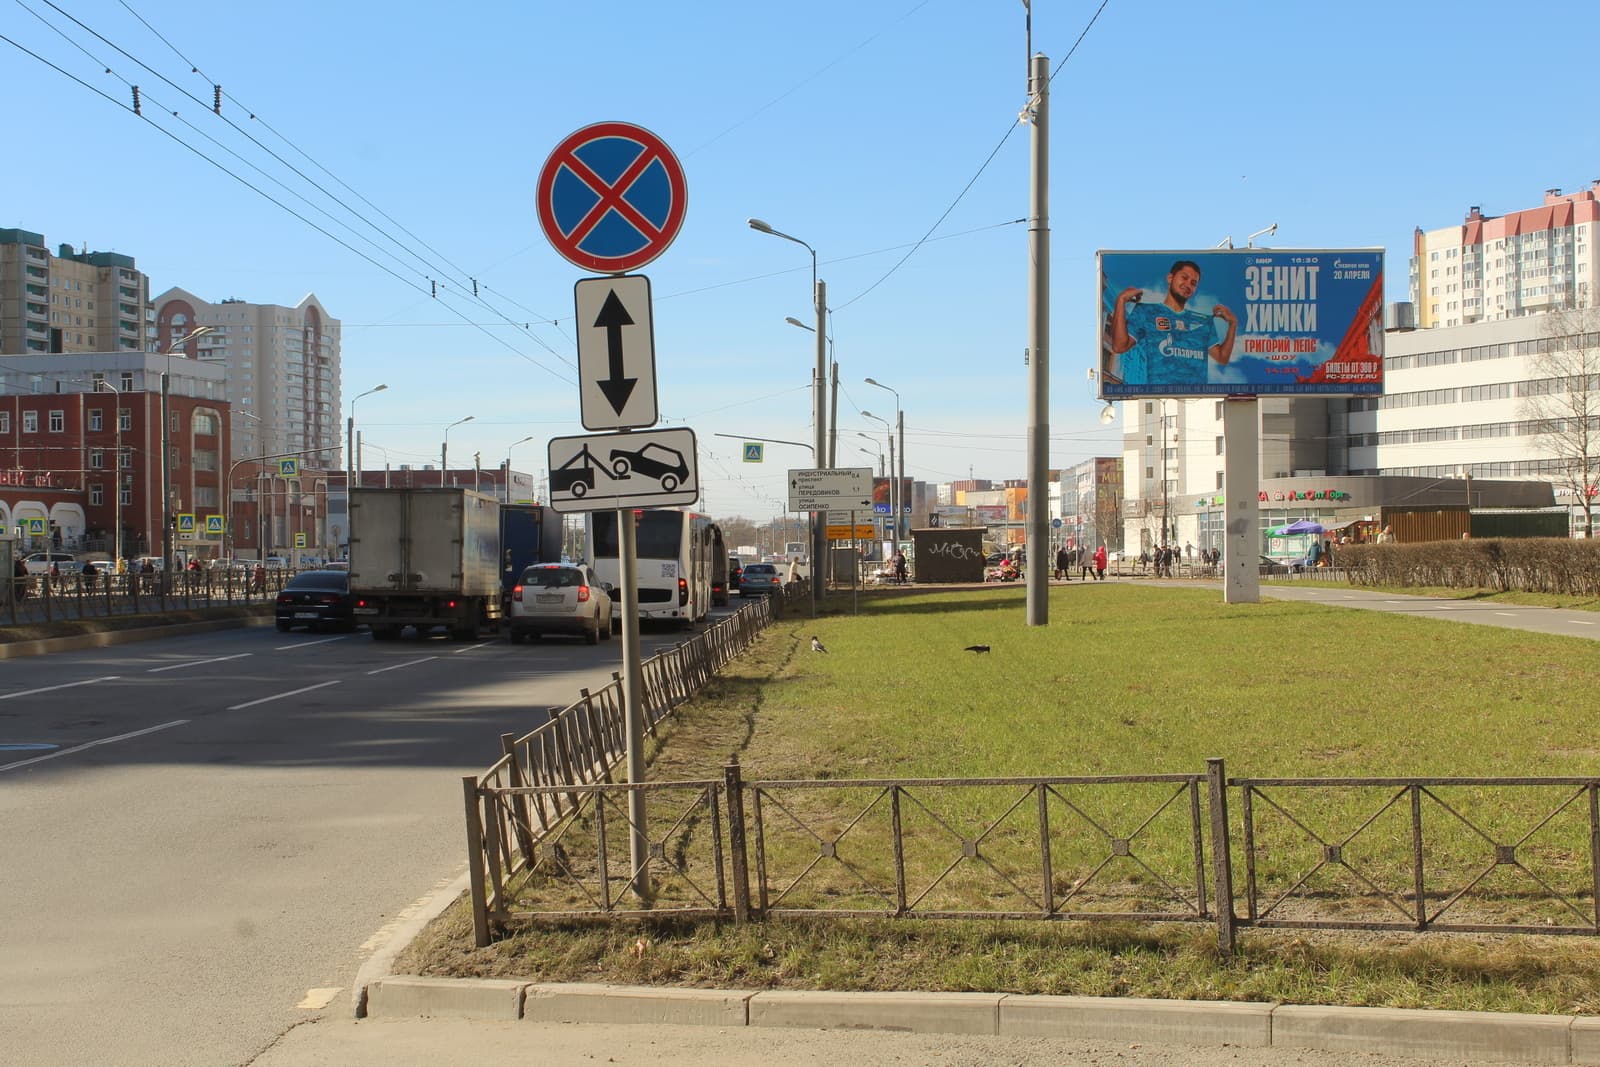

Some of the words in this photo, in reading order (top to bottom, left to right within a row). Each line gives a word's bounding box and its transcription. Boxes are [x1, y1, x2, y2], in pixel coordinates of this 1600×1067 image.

[1245, 266, 1319, 301] ЗЕНИТ
[1333, 270, 1343, 280] 20
[1344, 270, 1370, 280] АПРЕЛЯ
[1245, 303, 1317, 332] ХИМКИ
[1245, 336, 1291, 353] ГРИГОРИЙ
[1293, 338, 1317, 353] ЛЕПС
[1325, 362, 1350, 373] БИЛЕТЫ
[1351, 362, 1359, 373] ОТ
